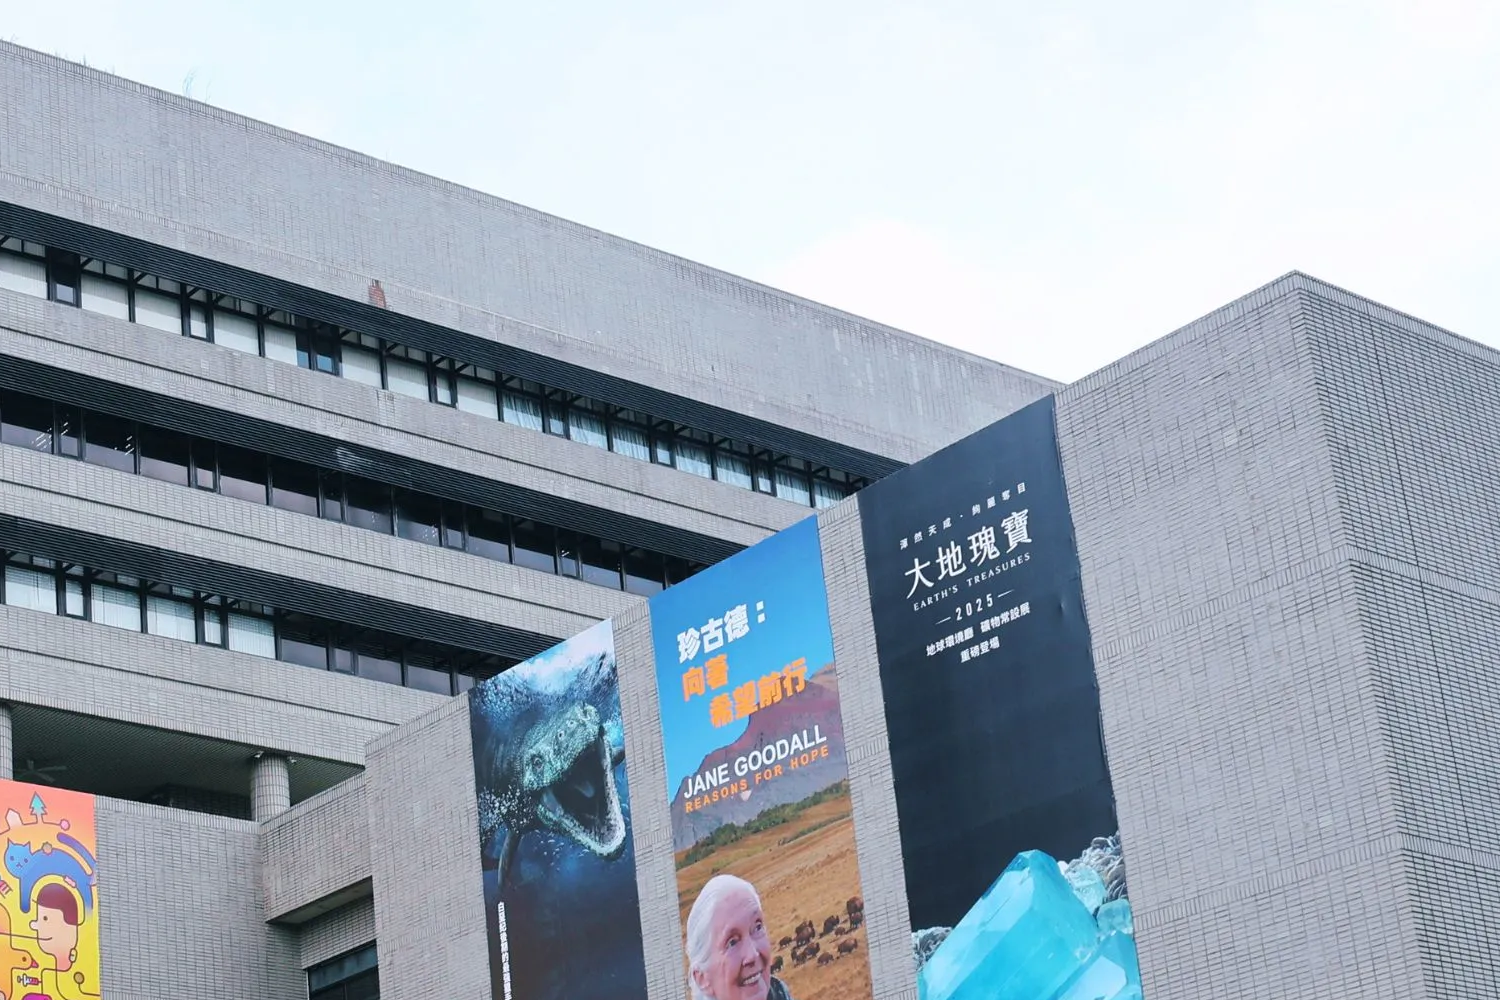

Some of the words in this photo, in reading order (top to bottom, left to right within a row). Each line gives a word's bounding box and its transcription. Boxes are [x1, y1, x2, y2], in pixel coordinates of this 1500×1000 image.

[904, 509, 1032, 600] 大地瑰寶
[913, 585, 959, 612] EARTH'S
[966, 552, 1031, 587] TREASURES
[955, 593, 993, 621] 2025
[960, 636, 1000, 663] 重磅登場
[709, 657, 807, 729] 希望前行
[683, 763, 730, 799] JANE
[734, 724, 827, 777] GOODALL
[685, 779, 748, 814] REASONS
[755, 764, 783, 785] FOR
[790, 745, 829, 770] HOPE
